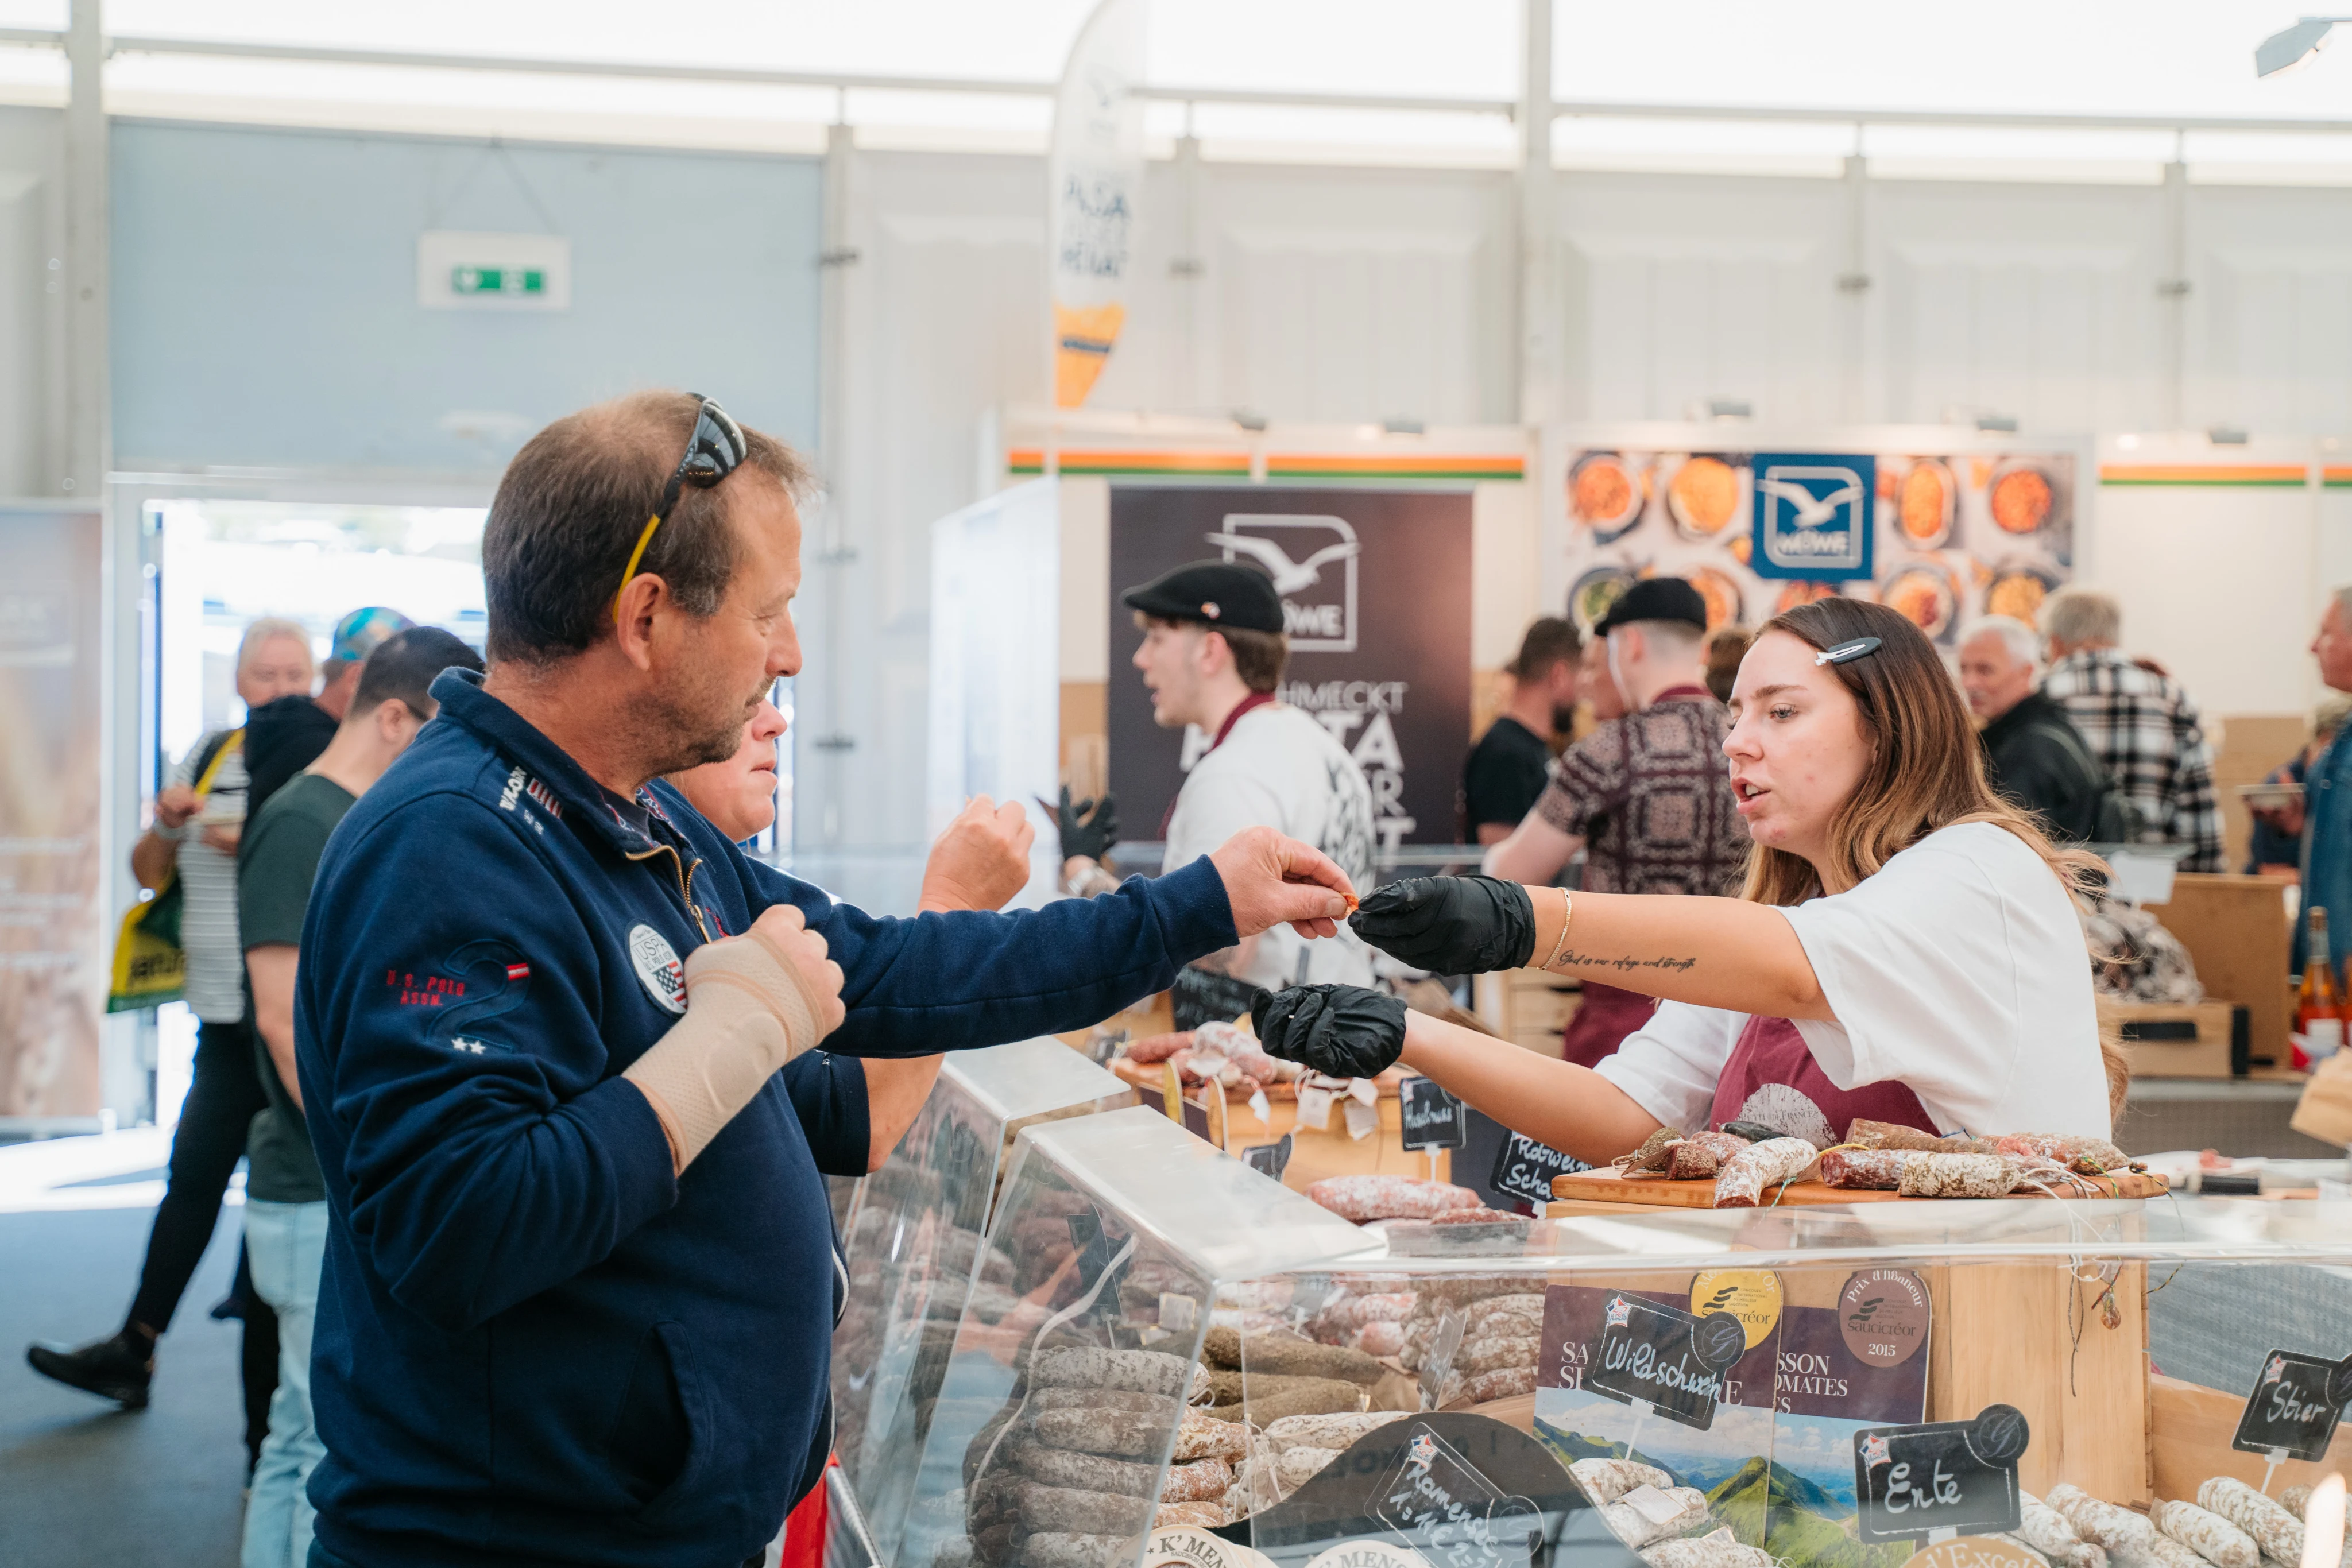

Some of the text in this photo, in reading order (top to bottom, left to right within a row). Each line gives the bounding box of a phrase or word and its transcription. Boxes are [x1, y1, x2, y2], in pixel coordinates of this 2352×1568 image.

[1276, 680, 1408, 714] HMECKT
[1557, 950, 1585, 967] God
[1583, 955, 1592, 966] is
[1612, 955, 1640, 971] refuge
[1643, 957, 1661, 968] and
[1661, 957, 1696, 973] strength
[386, 970, 465, 997] U.S. POLO
[1506, 1163, 1552, 1199] Scha
[1847, 1277, 1870, 1303] Prix
[1847, 1321, 1917, 1337] saucicréor
[1867, 1343, 1897, 1357] 2015
[2266, 1380, 2327, 1423] Stier
[1885, 1459, 1962, 1514] Ente
[1171, 1550, 1200, 1564] SAUCISSON
